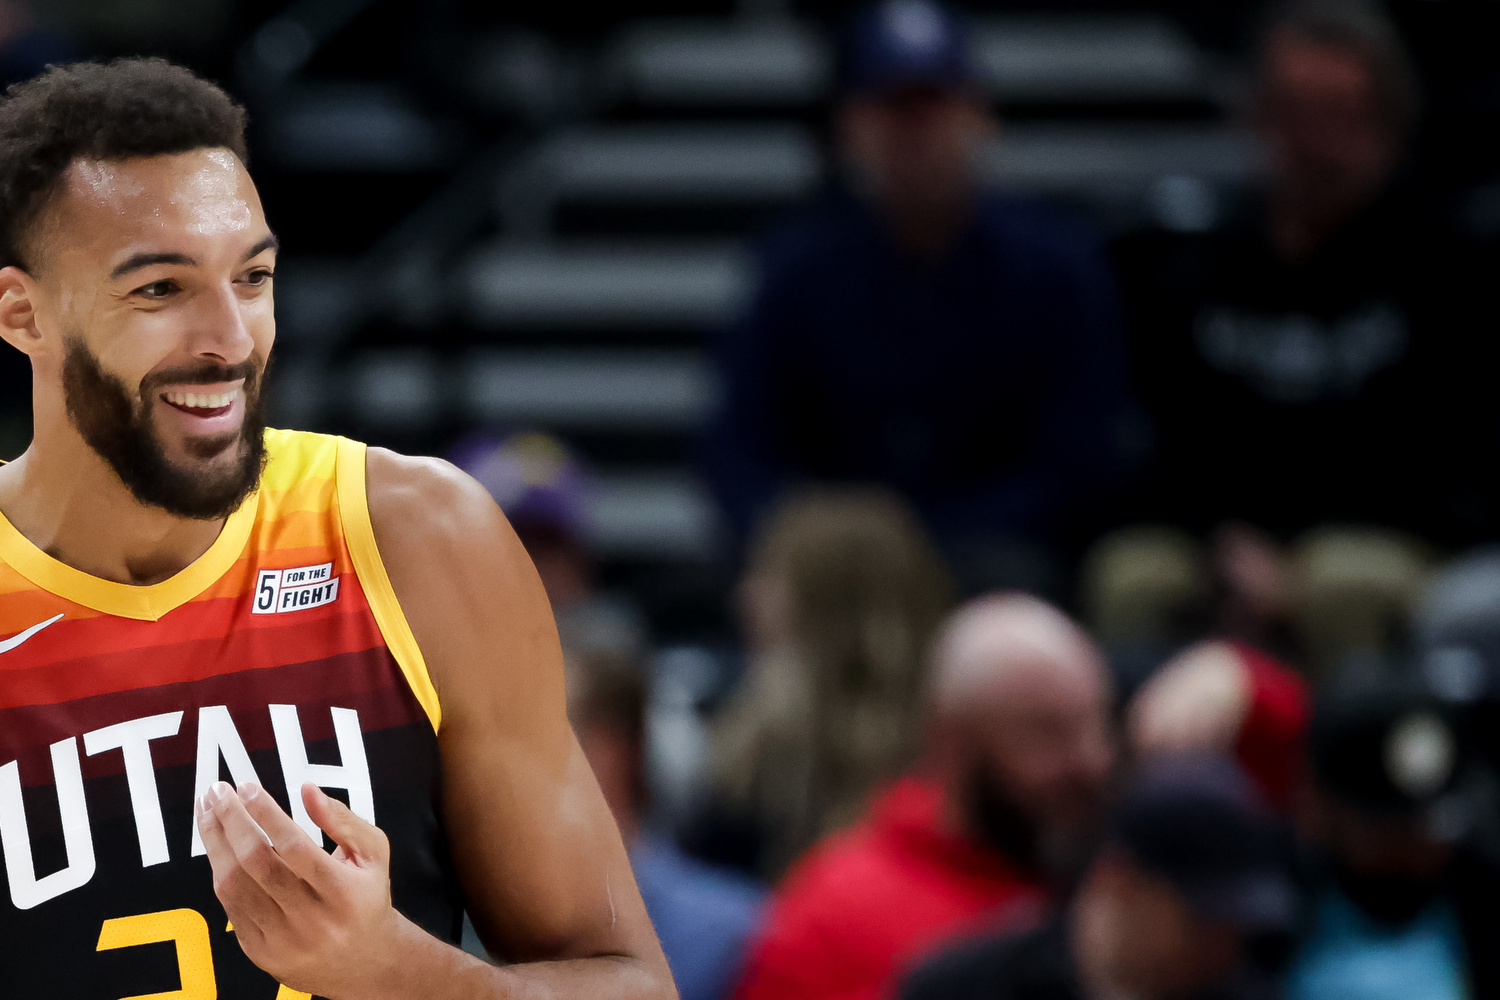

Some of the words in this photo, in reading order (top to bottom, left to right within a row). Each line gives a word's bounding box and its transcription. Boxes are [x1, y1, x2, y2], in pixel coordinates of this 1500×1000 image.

[287, 572, 305, 582] FOR
[309, 568, 326, 579] THE
[258, 575, 275, 610] 5
[283, 583, 334, 608] FIGHT
